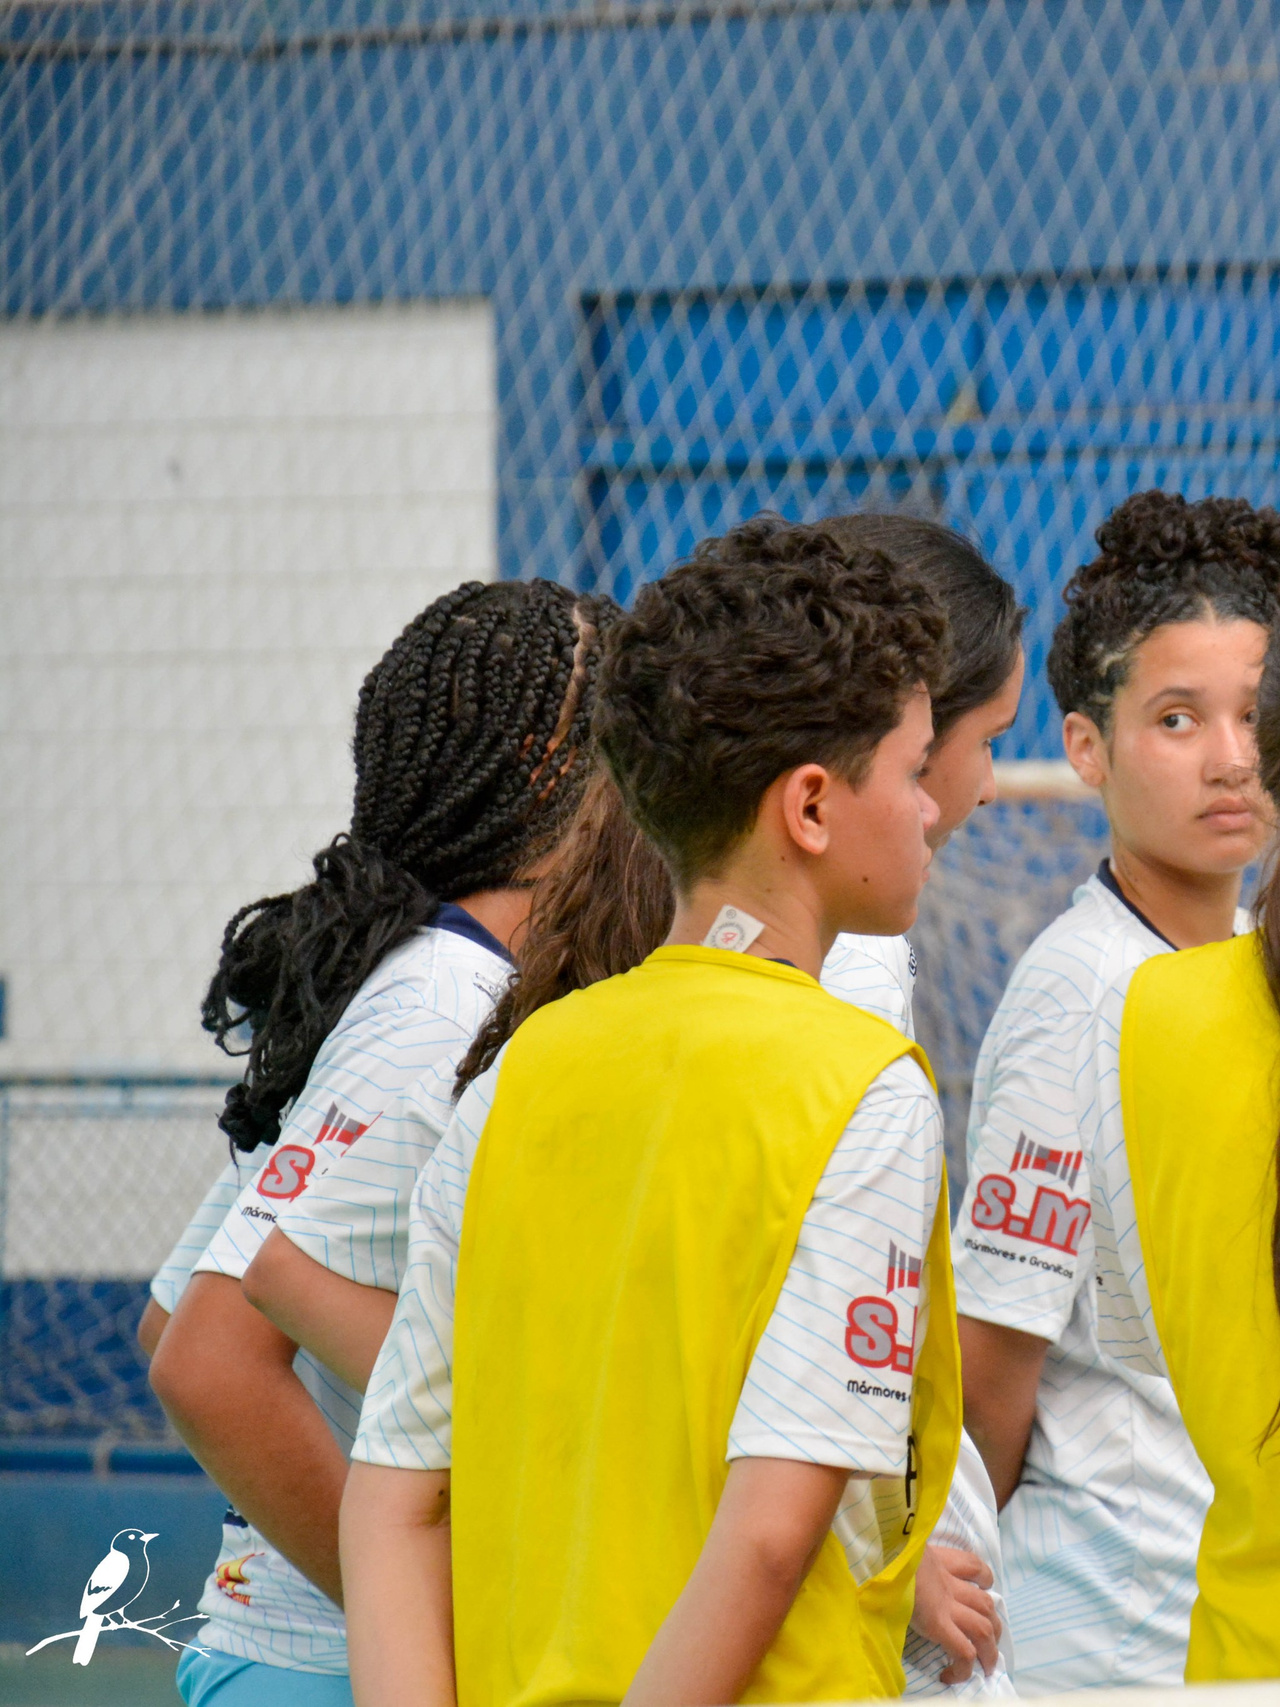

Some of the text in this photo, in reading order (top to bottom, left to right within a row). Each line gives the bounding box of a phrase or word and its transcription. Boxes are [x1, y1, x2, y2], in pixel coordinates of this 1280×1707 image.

[971, 1173, 1092, 1257] S.M
[964, 1238, 1074, 1280] Mármores e Granitos
[846, 1379, 907, 1402] Mármores
